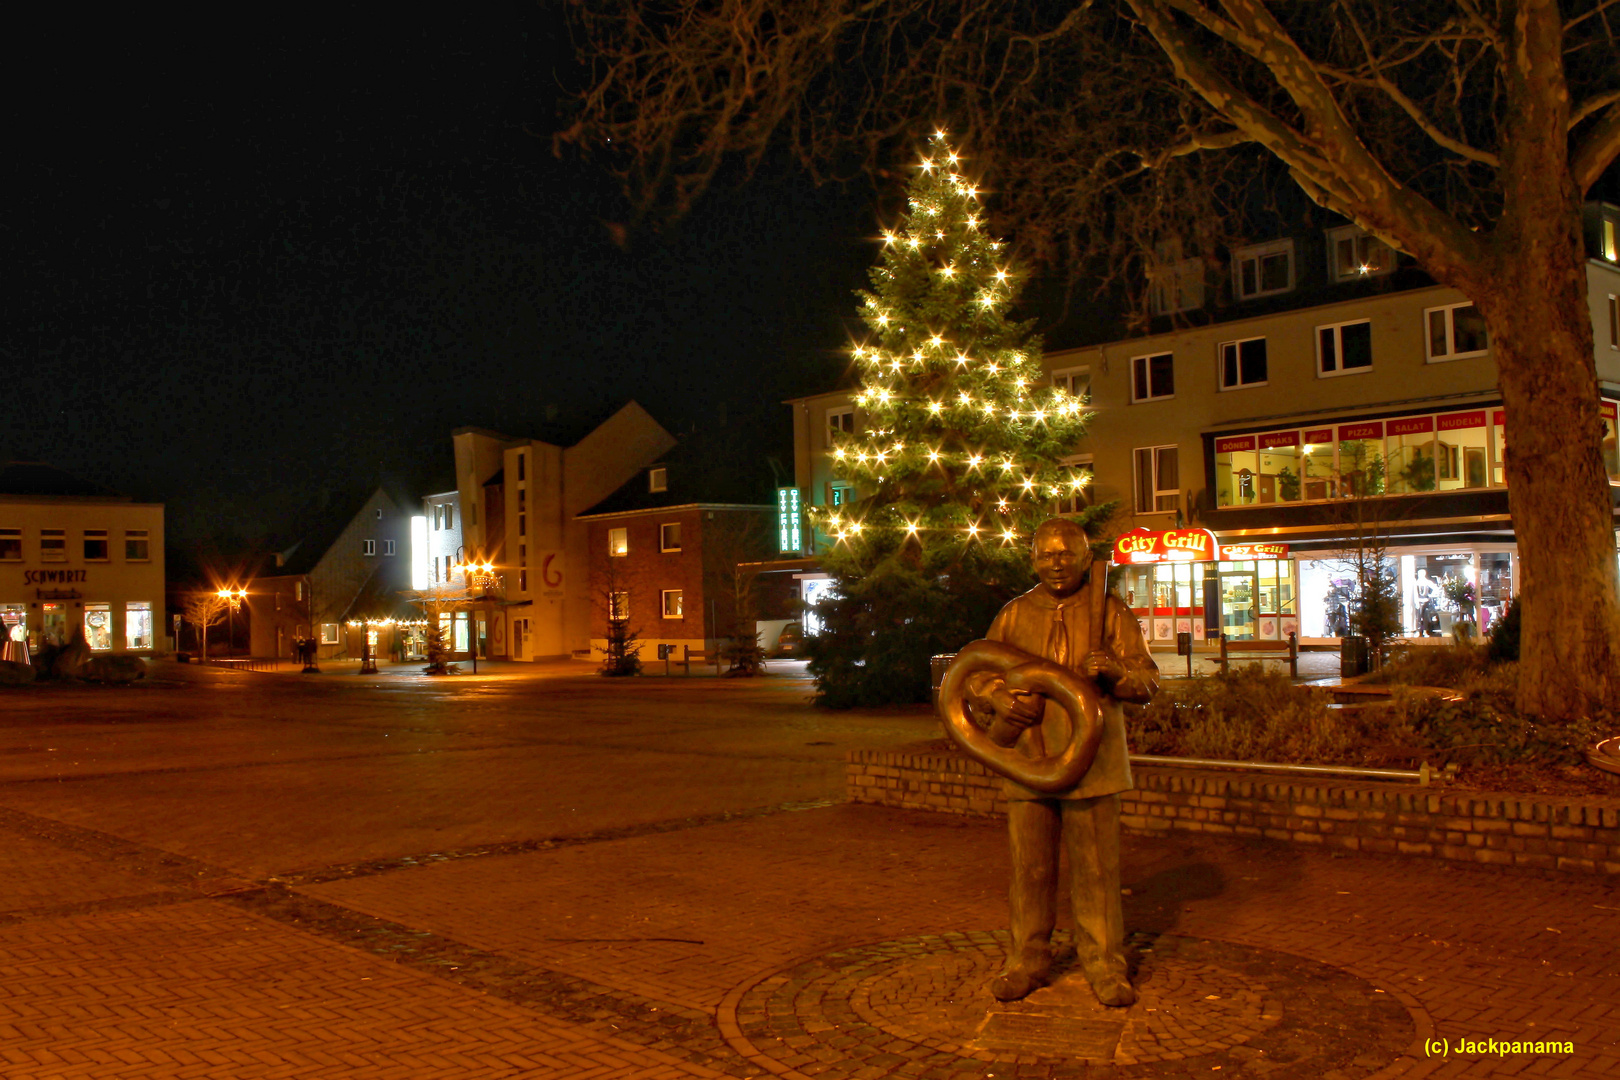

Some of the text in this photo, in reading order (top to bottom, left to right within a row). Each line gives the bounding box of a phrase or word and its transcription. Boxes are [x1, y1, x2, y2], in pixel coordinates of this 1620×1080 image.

[1395, 423, 1425, 433] SALAT
[1441, 417, 1482, 428] NUDELN
[1347, 428, 1374, 437] PIZZA
[1222, 441, 1250, 451] DÖNER
[1264, 436, 1293, 447] SNAKS
[1118, 531, 1207, 553] City Grill
[1222, 544, 1285, 555] City Grill
[24, 569, 87, 586] SCHWARTZ
